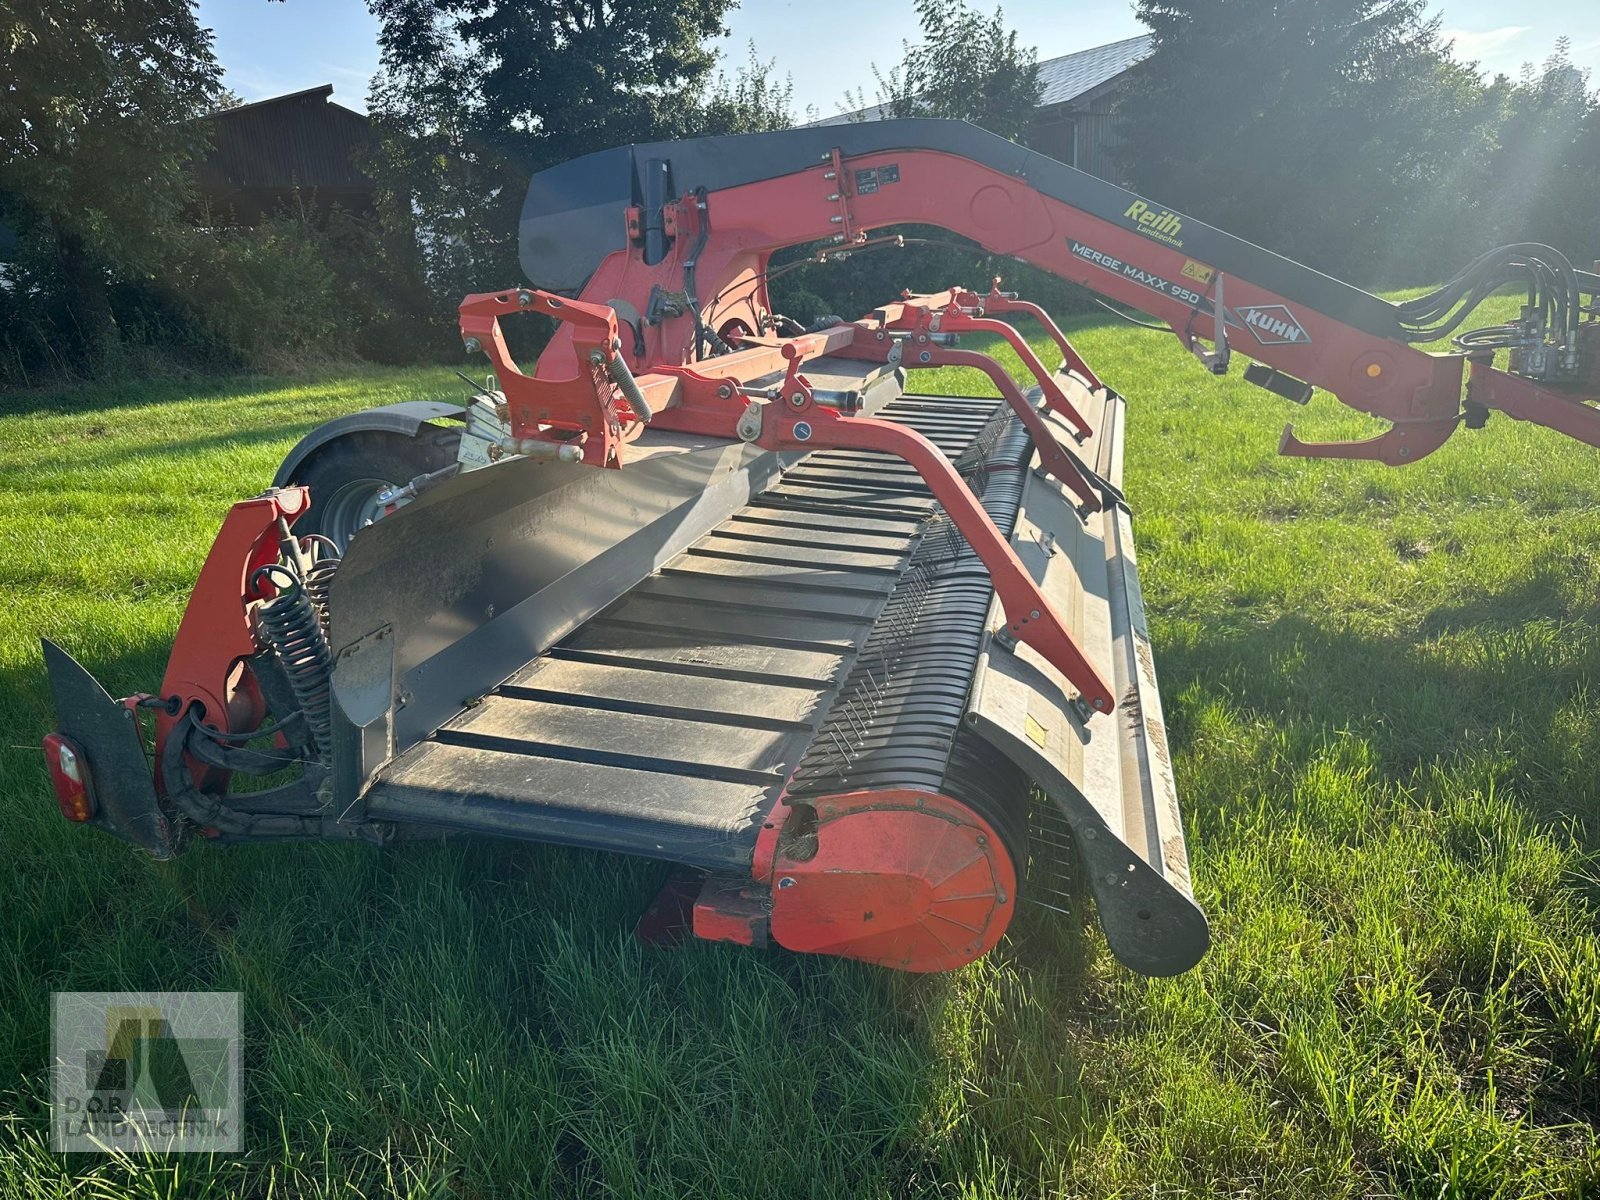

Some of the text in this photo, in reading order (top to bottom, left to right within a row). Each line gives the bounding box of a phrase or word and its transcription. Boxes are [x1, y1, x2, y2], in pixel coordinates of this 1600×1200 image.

[1124, 200, 1182, 236] Reith
[1136, 224, 1184, 248] Landtechnik
[1072, 243, 1199, 304] MERGE MAXX 950
[1246, 309, 1300, 341] KUHN
